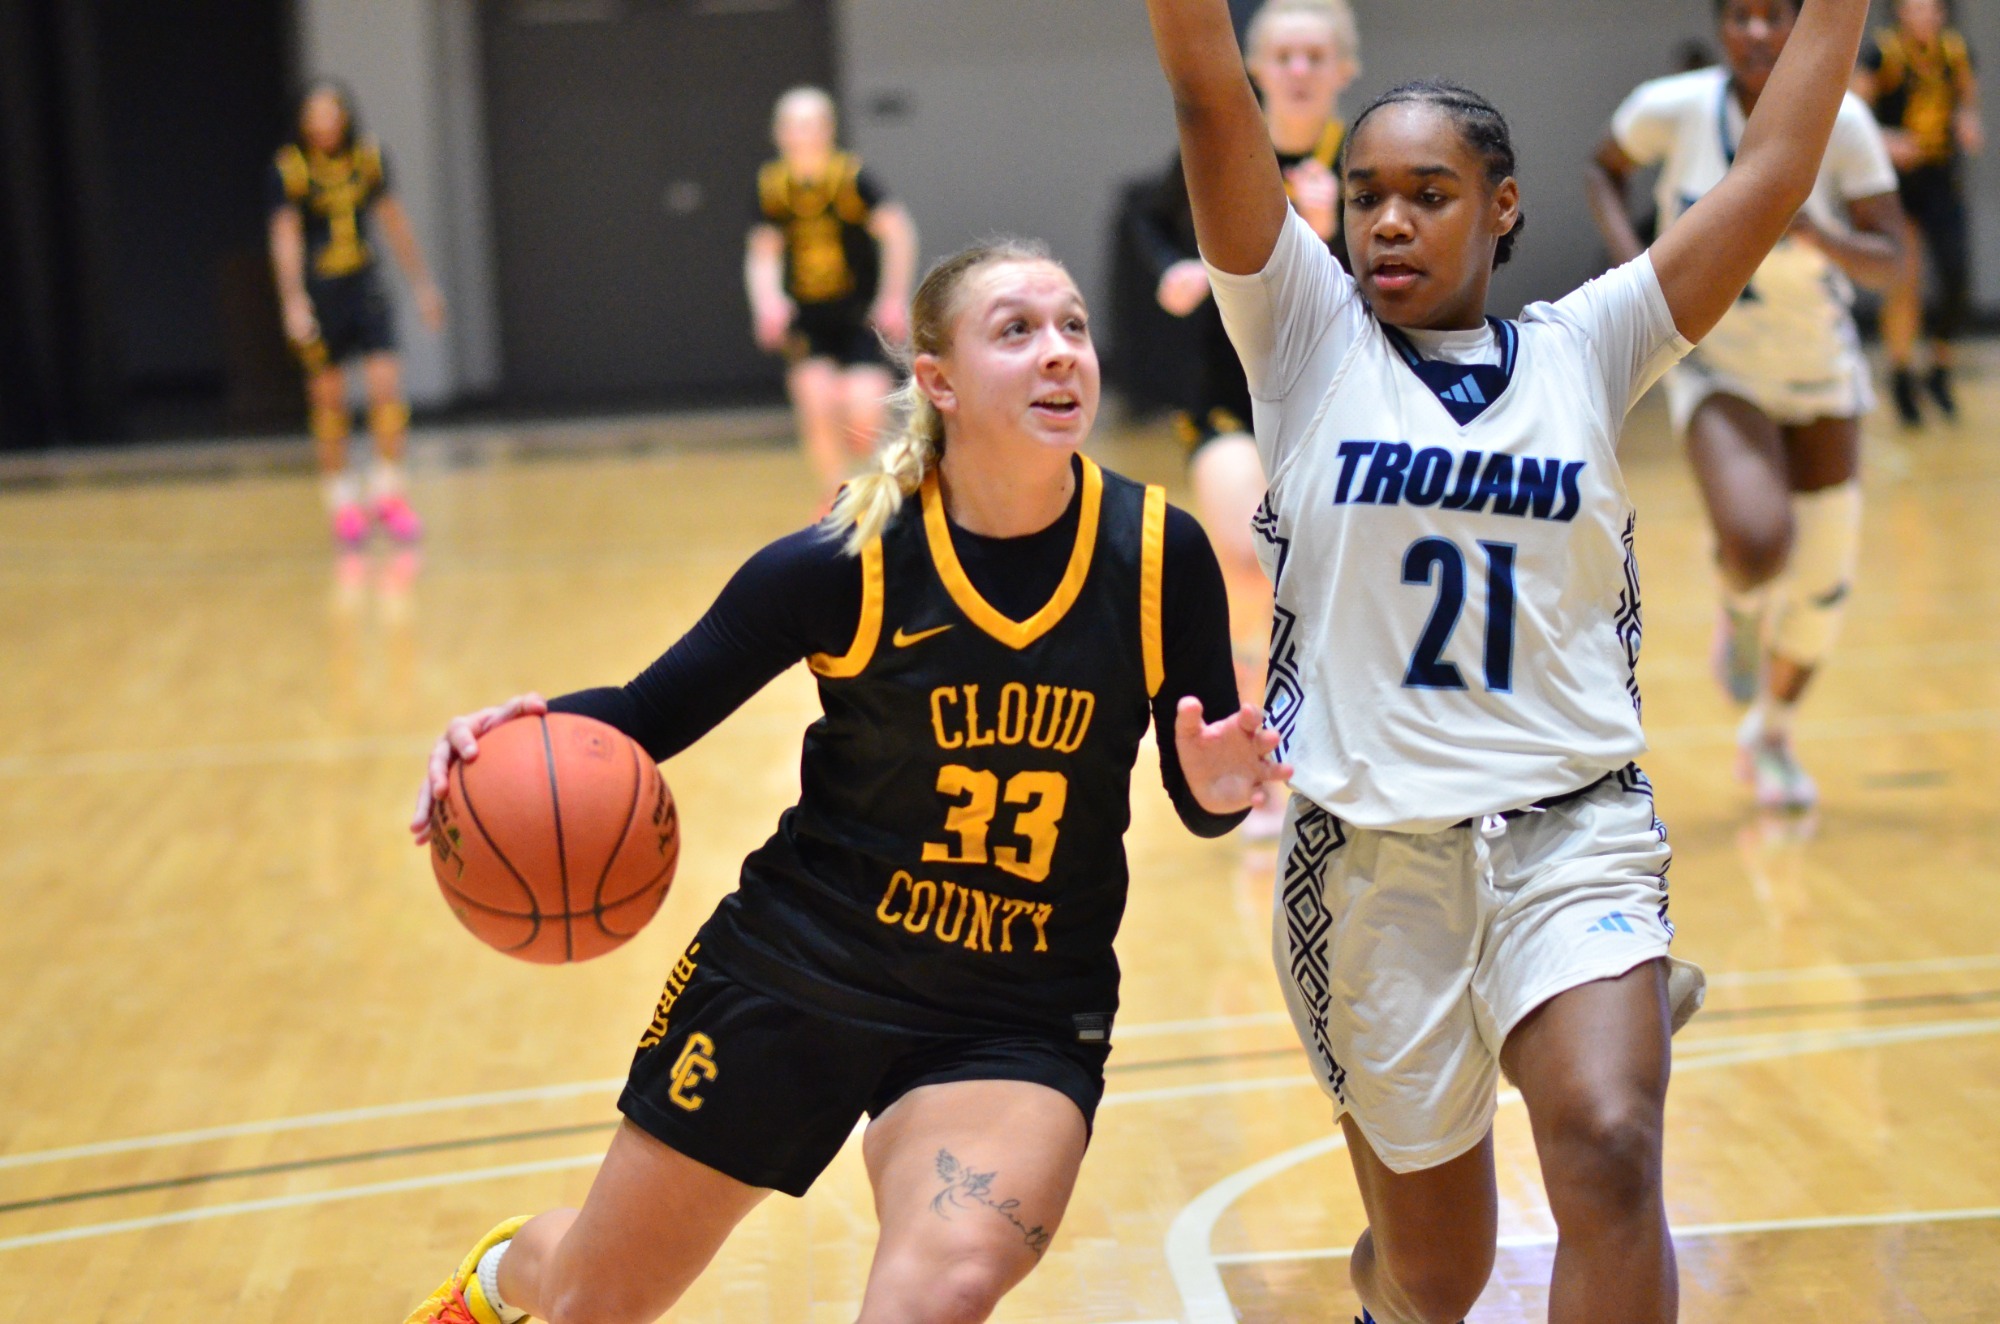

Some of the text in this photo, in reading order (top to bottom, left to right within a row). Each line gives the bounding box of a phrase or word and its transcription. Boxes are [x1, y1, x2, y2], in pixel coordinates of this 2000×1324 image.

[1332, 440, 1587, 523] TROJANS
[1400, 535, 1517, 694] 21
[930, 682, 1095, 753] CLOUD
[921, 764, 1068, 882] 33
[877, 870, 1053, 952] COUNTY
